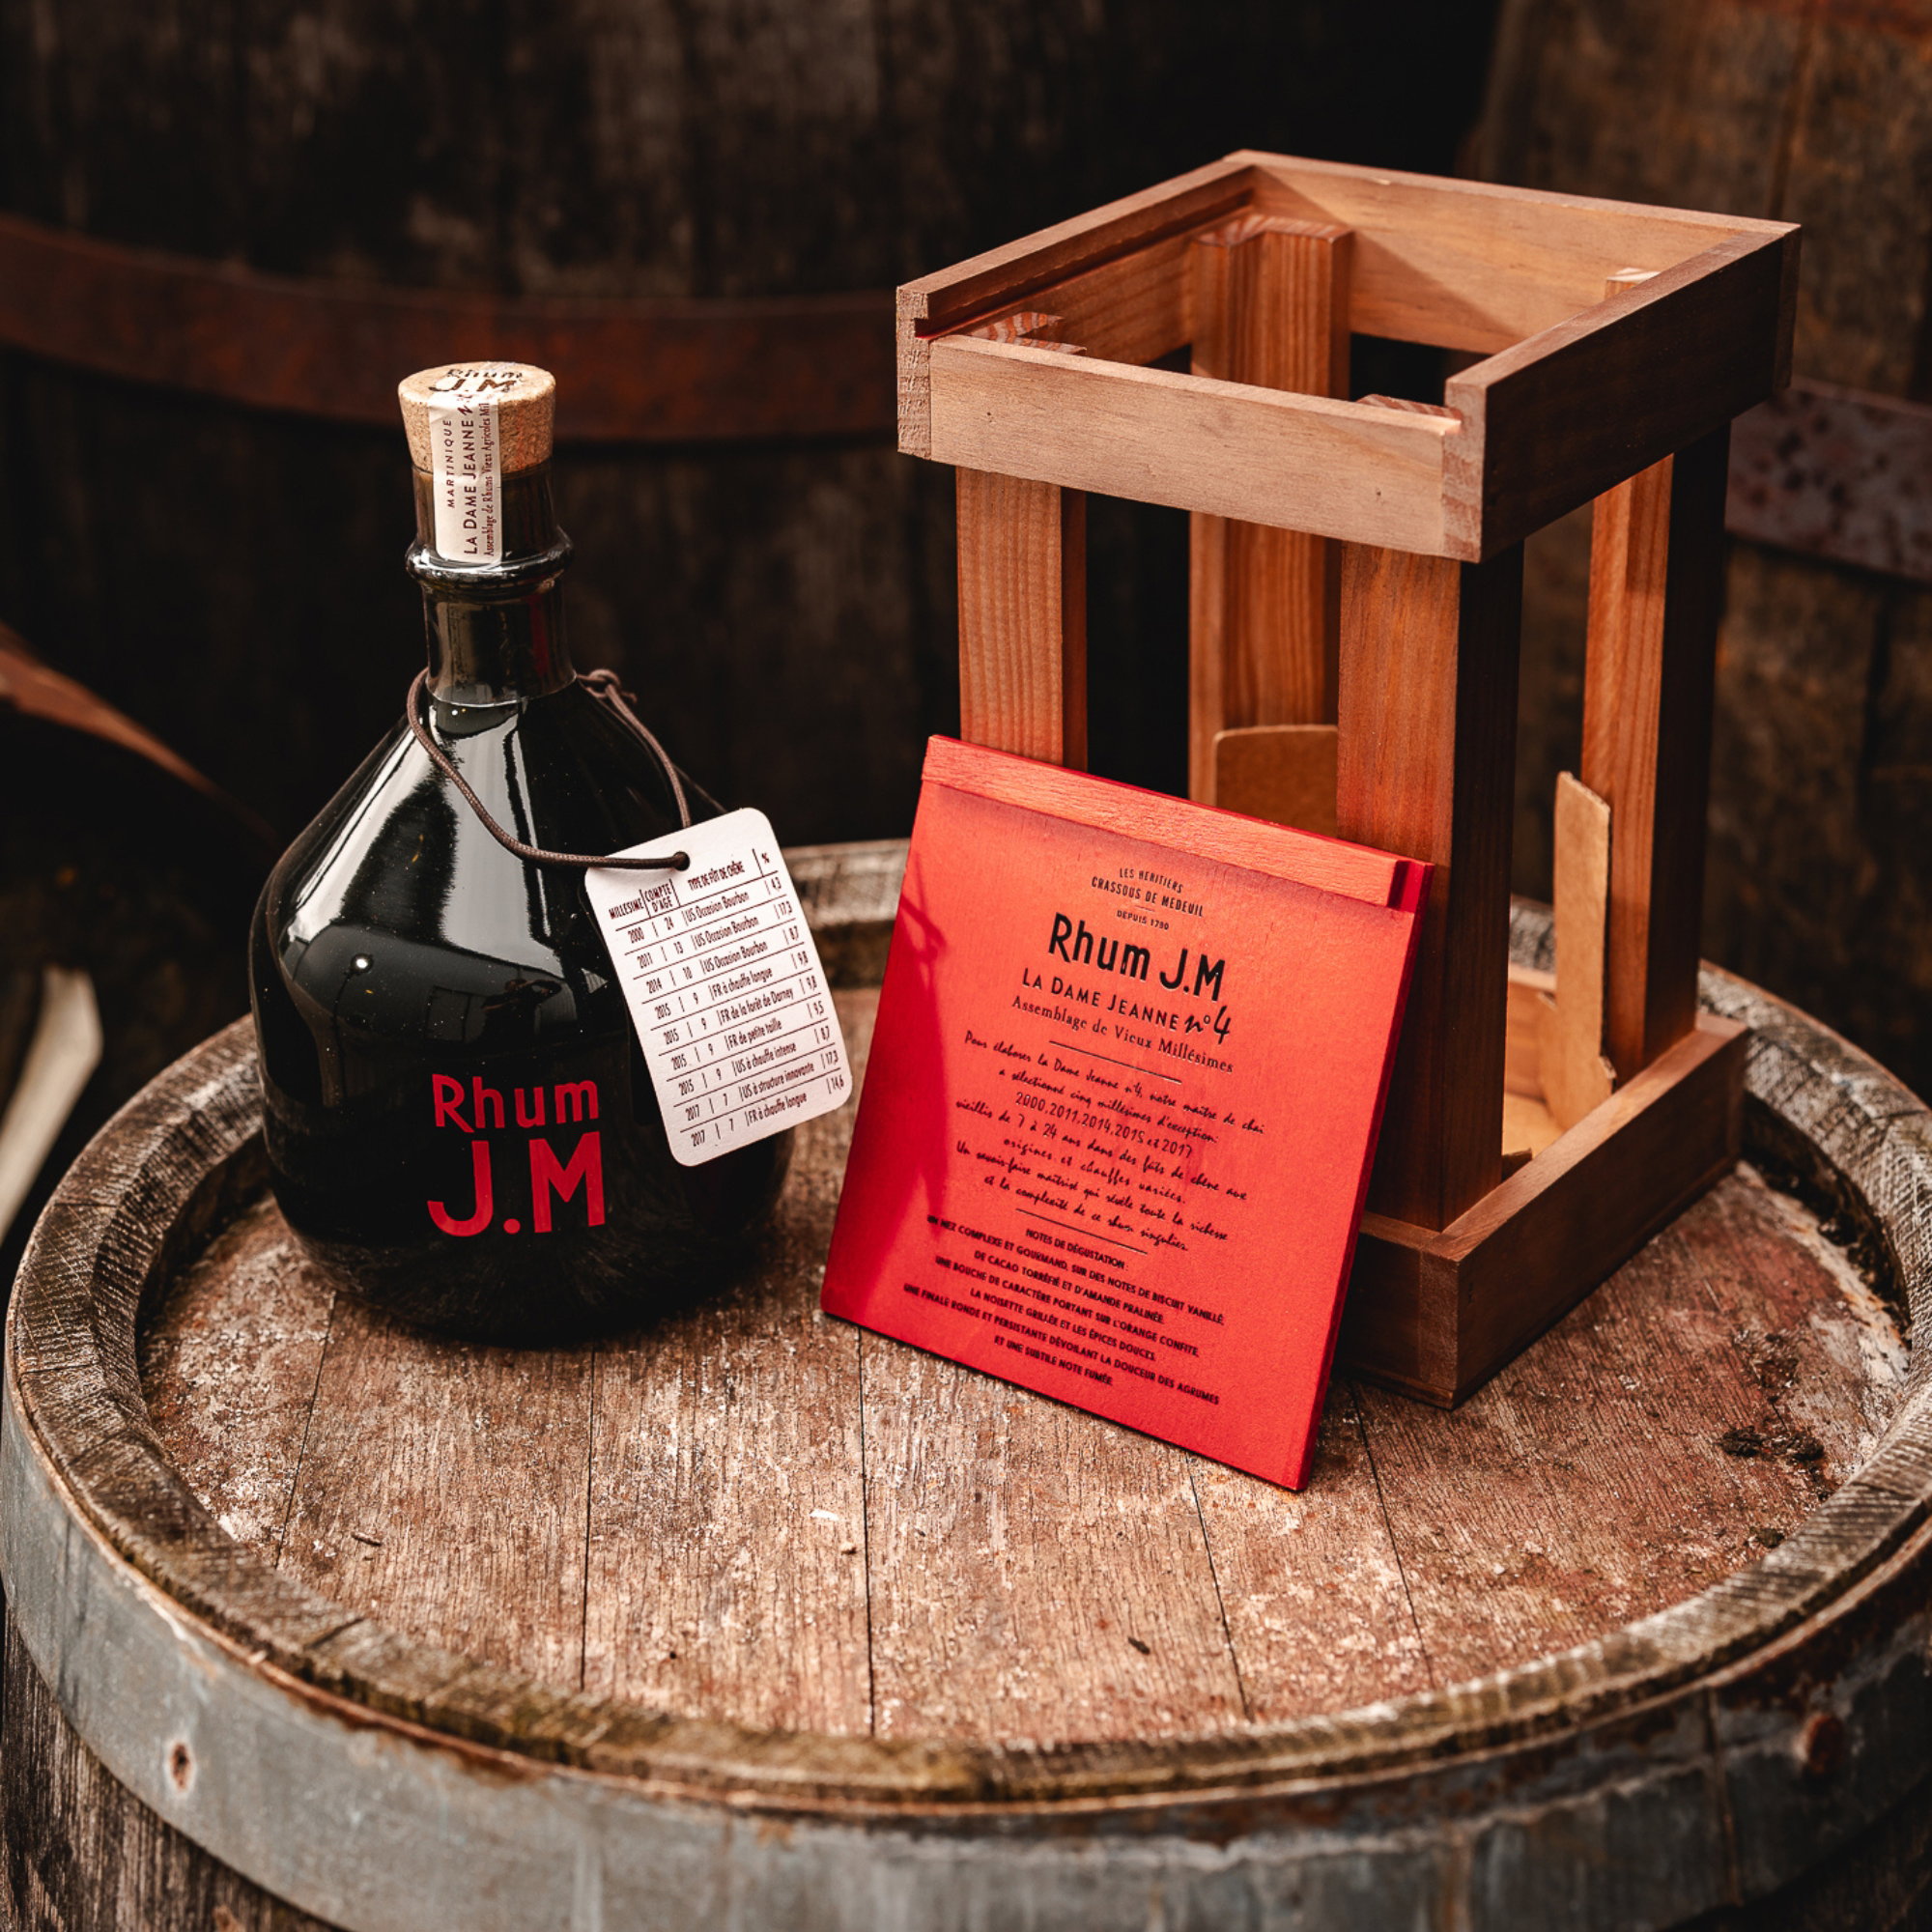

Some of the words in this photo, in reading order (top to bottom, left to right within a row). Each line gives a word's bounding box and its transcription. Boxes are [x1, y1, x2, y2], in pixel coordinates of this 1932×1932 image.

[461, 419, 477, 479] JEANNE
[479, 419, 495, 449] Agricoles
[443, 419, 455, 508] MARTINIQUE
[463, 486, 477, 529] DAME
[482, 475, 494, 504] Rhums
[482, 505, 494, 516] de
[464, 536, 477, 555] LA
[481, 515, 497, 557] Assemblage
[1119, 867, 1134, 879] LES
[1091, 875, 1141, 899] CRASSOUS
[1145, 890, 1157, 904] DE
[1160, 895, 1203, 917] MEDEUIL
[1116, 909, 1147, 924] DEPUIS
[1048, 911, 1151, 980] Rhum
[1158, 948, 1226, 1002] J.M
[1021, 967, 1042, 990] LA
[1050, 976, 1101, 1008] DAME
[1106, 994, 1179, 1031] JEANNE
[1011, 995, 1088, 1032] Assemblage
[1092, 1018, 1108, 1036] de
[1114, 1024, 1152, 1049] Vieux
[1157, 1037, 1234, 1073] Millésimes
[432, 1073, 599, 1133] Rhum
[1053, 1058, 1079, 1077] Dame
[1085, 1068, 1119, 1089] Jeanne
[1222, 1112, 1236, 1125] de
[997, 1110, 1010, 1122] de
[1161, 1138, 1193, 1158] 2017
[427, 1131, 606, 1237] J.M
[1025, 1228, 1053, 1245] NOTES
[1053, 1237, 1065, 1249] DE
[957, 1225, 1003, 1247] COMPLEXE
[1004, 1240, 1014, 1251] ET
[1089, 1270, 1105, 1283] DES
[1107, 1276, 1136, 1294] NOTES
[1137, 1287, 1151, 1299] DE
[1151, 1292, 1185, 1311] BISCUIT
[974, 1250, 985, 1261] DE
[987, 1255, 1019, 1272] CACAO
[1061, 1280, 1072, 1292] ET
[952, 1262, 986, 1281] BOUCHE
[987, 1274, 1000, 1286] DE
[1052, 1297, 1094, 1319] PORTANT
[970, 1288, 981, 1298] LA
[982, 1292, 1024, 1314] NOISETTE
[1059, 1319, 1071, 1330] ET
[1071, 1323, 1087, 1336] LES
[921, 1290, 950, 1307] FINALE
[951, 1299, 980, 1318] RONDE
[981, 1311, 993, 1321] ET
[993, 1315, 1047, 1342] PERSISTANTE
[1099, 1353, 1112, 1366] LA
[1113, 1358, 1156, 1381] DOUCEUR
[1157, 1375, 1175, 1388] DES
[1176, 1382, 1219, 1406] AGRUMES
[993, 1335, 1005, 1346] ET
[1058, 1359, 1083, 1375] NOTE
